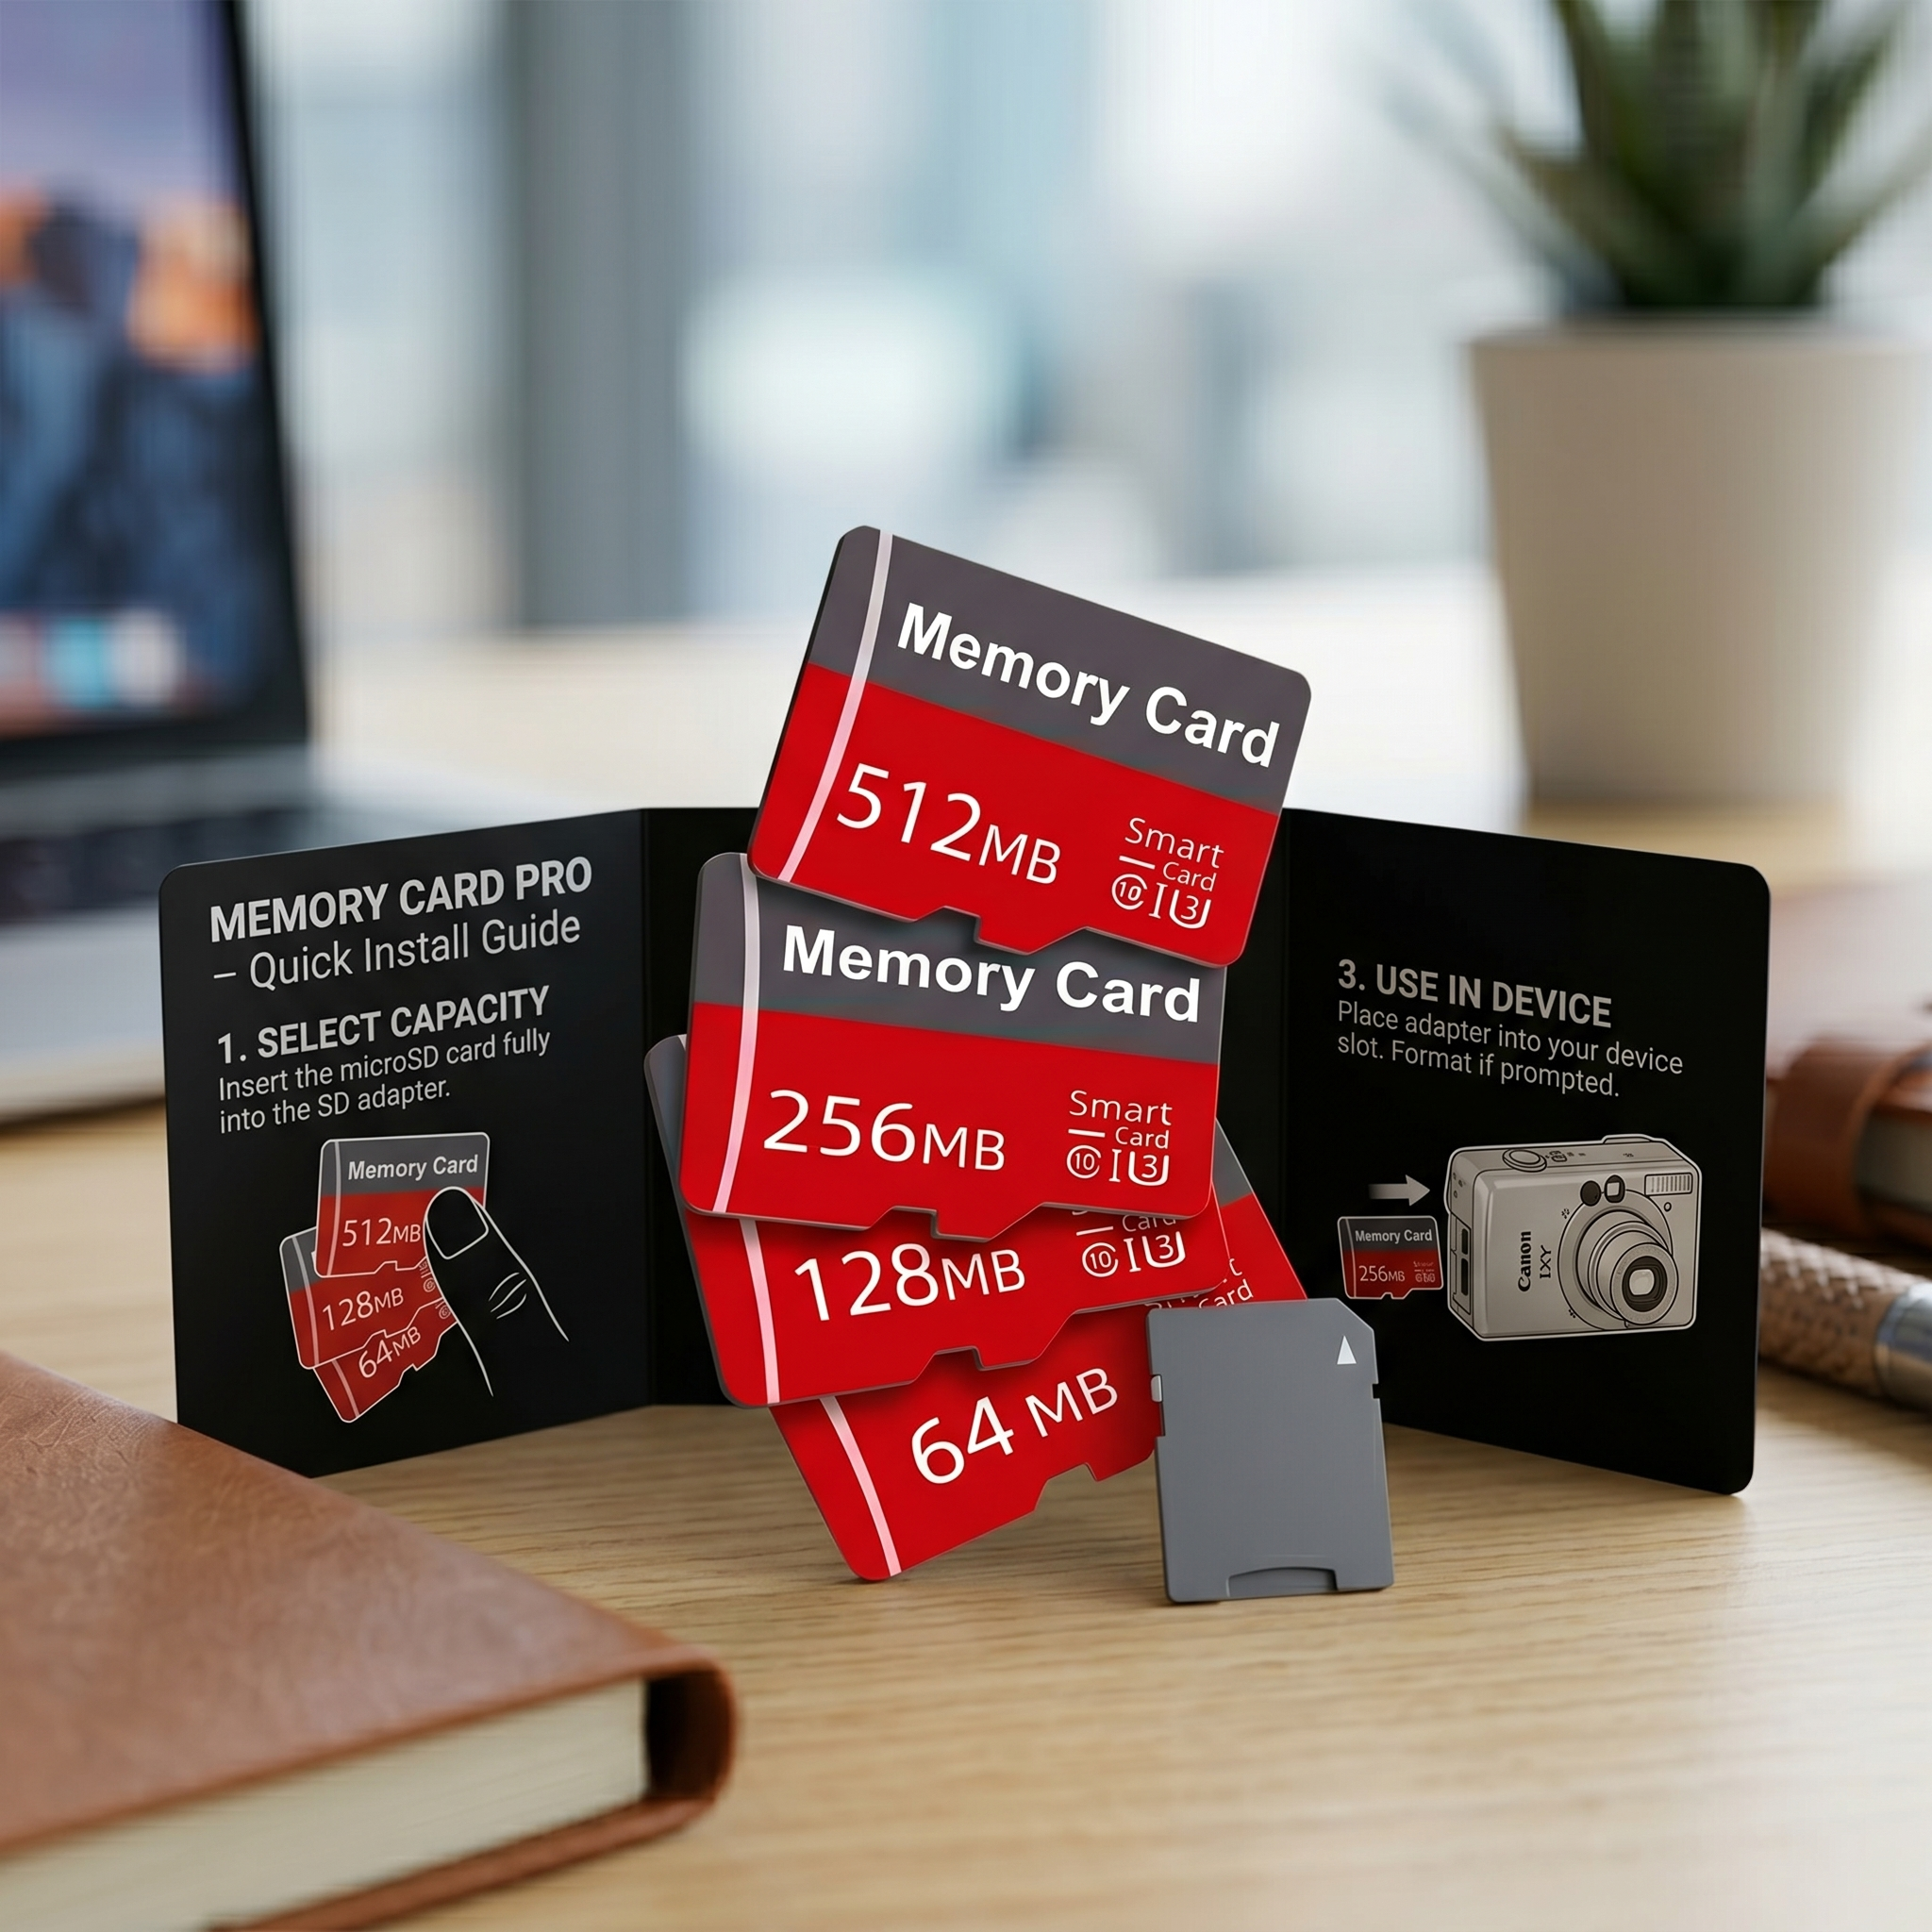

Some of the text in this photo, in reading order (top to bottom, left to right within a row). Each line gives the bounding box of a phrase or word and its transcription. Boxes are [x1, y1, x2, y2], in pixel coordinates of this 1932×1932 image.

[897, 602, 1280, 768] Memory Card
[837, 763, 1060, 884] 512MB
[1124, 817, 1224, 869] Smart
[210, 856, 592, 943] MEMORY CARD PRO
[1162, 861, 1217, 892] Card
[250, 940, 354, 991] Quick
[365, 922, 469, 973] Install
[482, 908, 580, 955] Guide
[783, 924, 1200, 1023] Memory Card
[218, 985, 550, 1064] 1. SELECT CAPACITY
[1338, 958, 1612, 1028] 3. USE IN DEVICE
[219, 1027, 551, 1101] Insert the microSD card fully
[1338, 1031, 1619, 1097] slot. Format if prompted.
[1339, 1000, 1683, 1074] Place adapter into your device
[220, 1079, 450, 1134] into the SD adapter.
[763, 1090, 1005, 1171] 256MB
[1069, 1090, 1173, 1126] Smart
[1115, 1126, 1170, 1149] Card
[348, 1154, 478, 1181] Memory Card
[342, 1217, 421, 1247] 512MB
[1355, 1228, 1433, 1244] Memory Card
[1517, 1231, 1532, 1292] Canon
[1539, 1244, 1552, 1279] IXY
[323, 1288, 404, 1331] 128MB
[794, 1243, 1025, 1321] 128MB
[358, 1326, 421, 1378] 64MB
